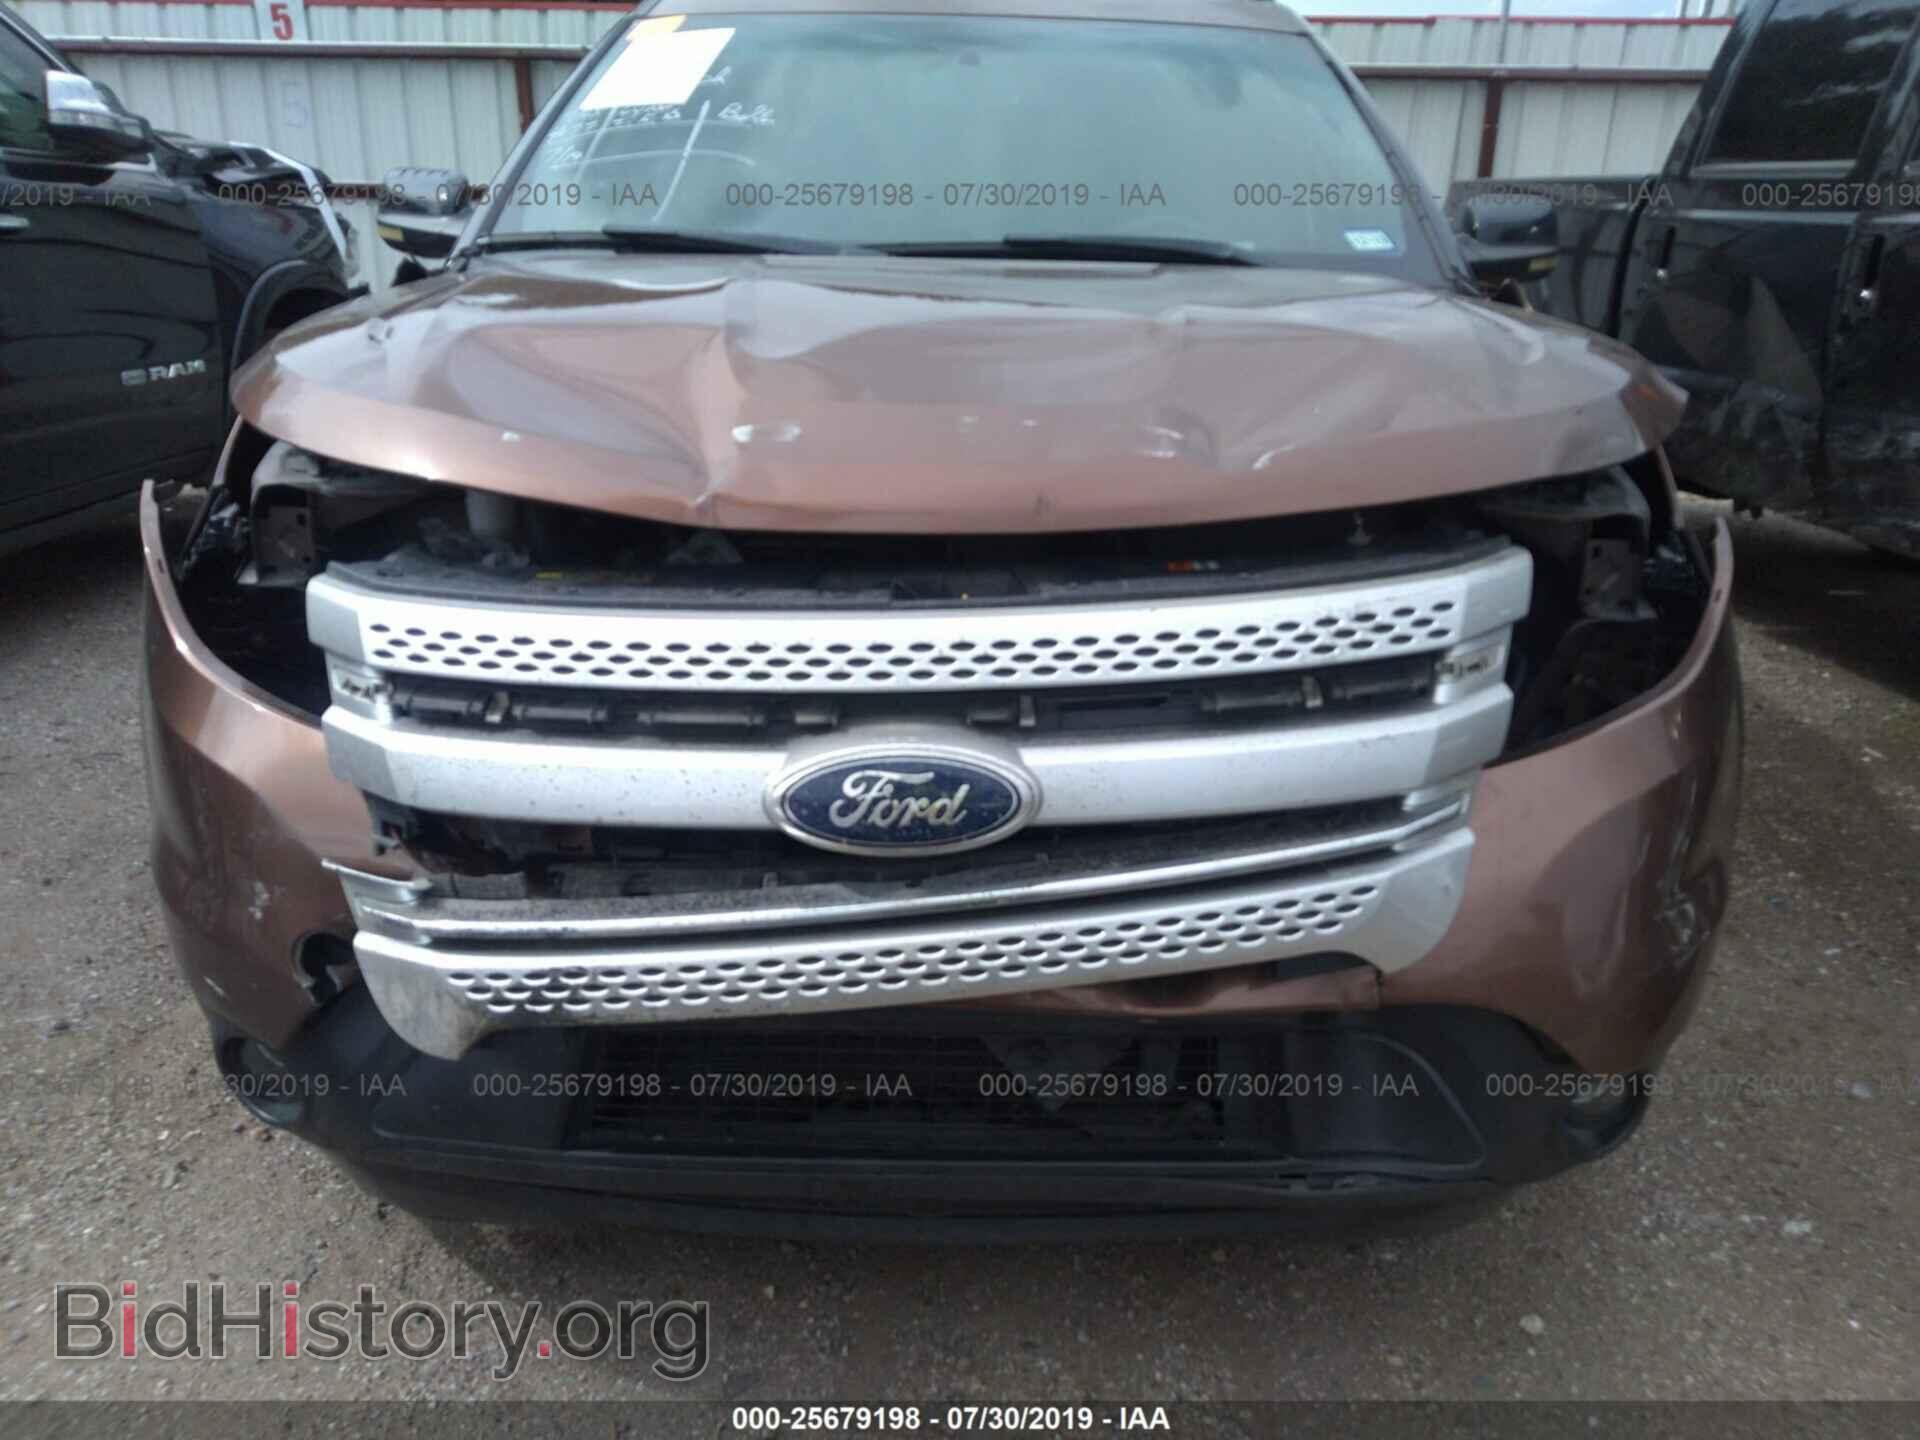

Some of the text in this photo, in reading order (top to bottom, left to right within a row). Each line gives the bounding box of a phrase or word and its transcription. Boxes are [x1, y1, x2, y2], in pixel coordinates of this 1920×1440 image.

[270, 3, 294, 41] 5
[148, 359, 207, 381] RAM
[829, 769, 970, 829] Ford
